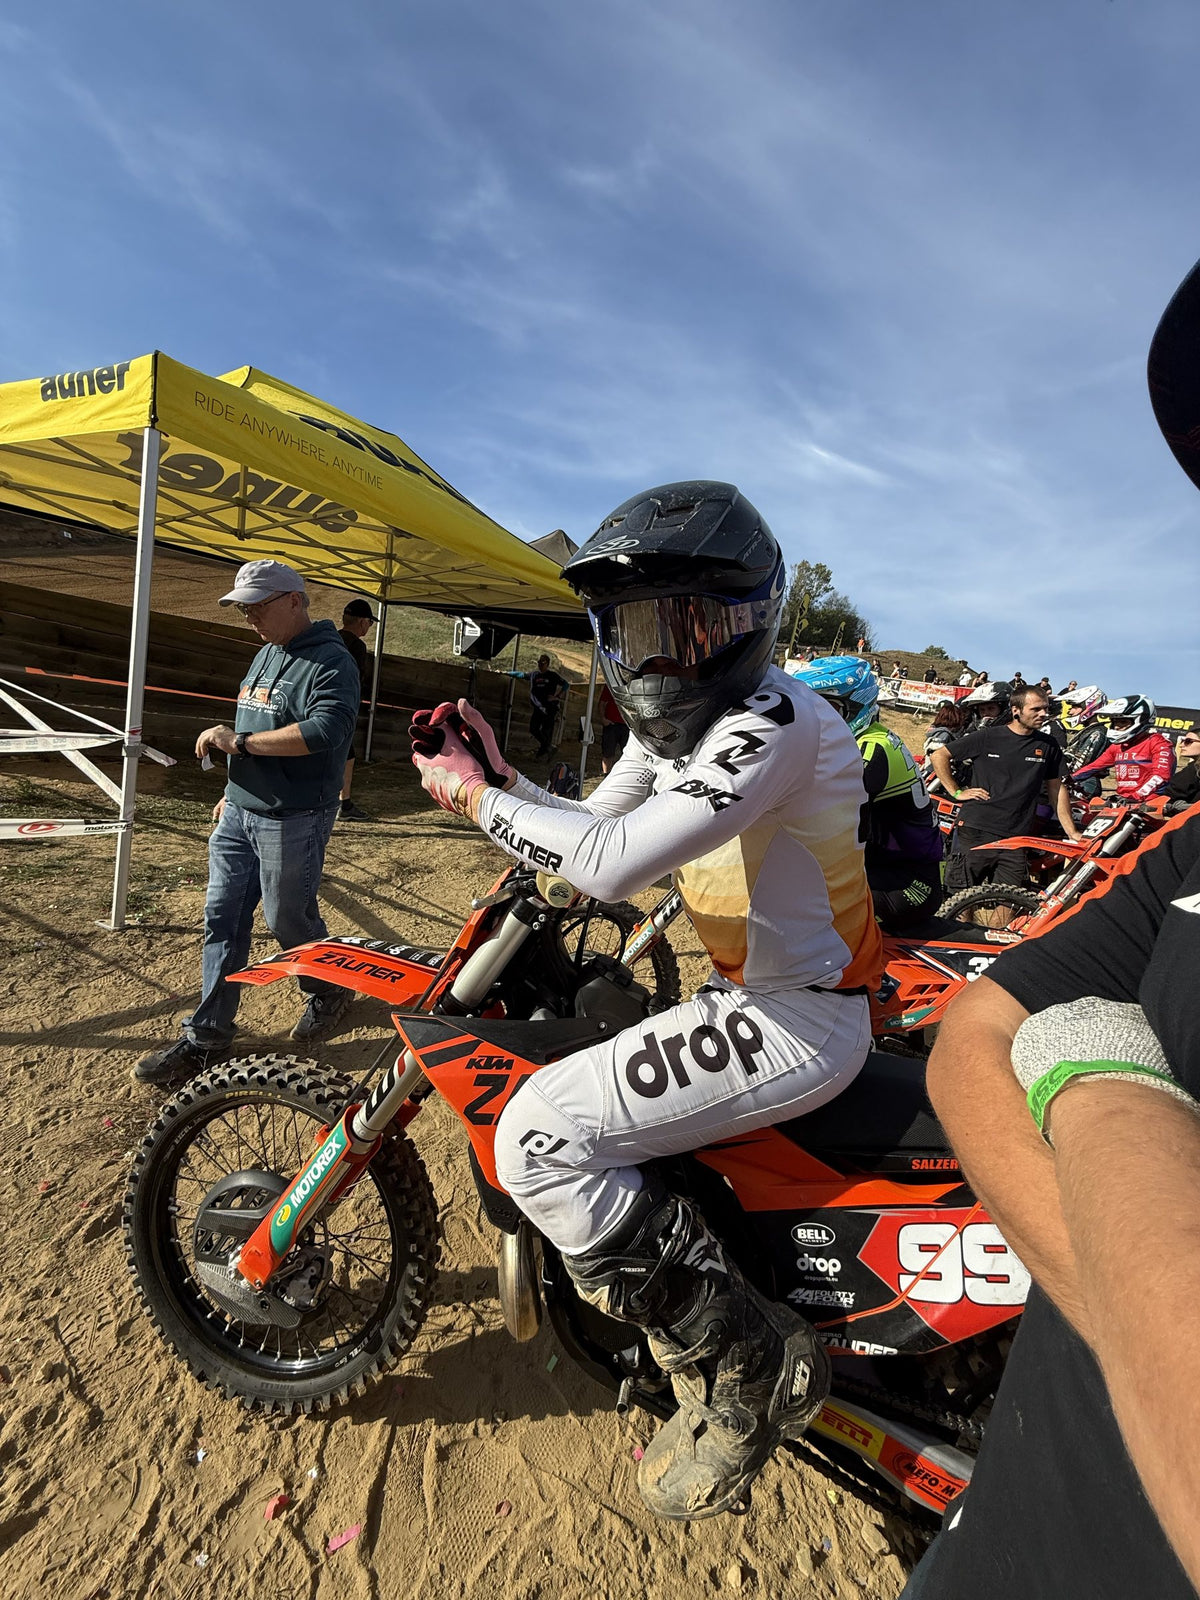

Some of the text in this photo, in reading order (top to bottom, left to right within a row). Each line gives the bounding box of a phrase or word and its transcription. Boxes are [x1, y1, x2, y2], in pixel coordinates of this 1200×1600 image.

[40, 361, 131, 402] auner
[194, 391, 384, 491] RIDE ANYWHERE, ANYTIME
[489, 818, 564, 874] ZAUNER
[622, 928, 652, 962] MOTOREX
[312, 952, 406, 984] ZAUNER
[464, 1055, 515, 1071] KTM
[626, 1009, 764, 1099] drop
[290, 1132, 342, 1208] MOTOREX
[911, 1158, 959, 1170] SALZER
[797, 1228, 830, 1241] BELL
[796, 1252, 842, 1277] drop
[898, 1221, 1032, 1306] 99
[814, 1296, 855, 1305] FOUR
[815, 1289, 856, 1300] FOURTY
[817, 1405, 874, 1448] ELLI
[904, 1461, 958, 1498] MEFO-M
